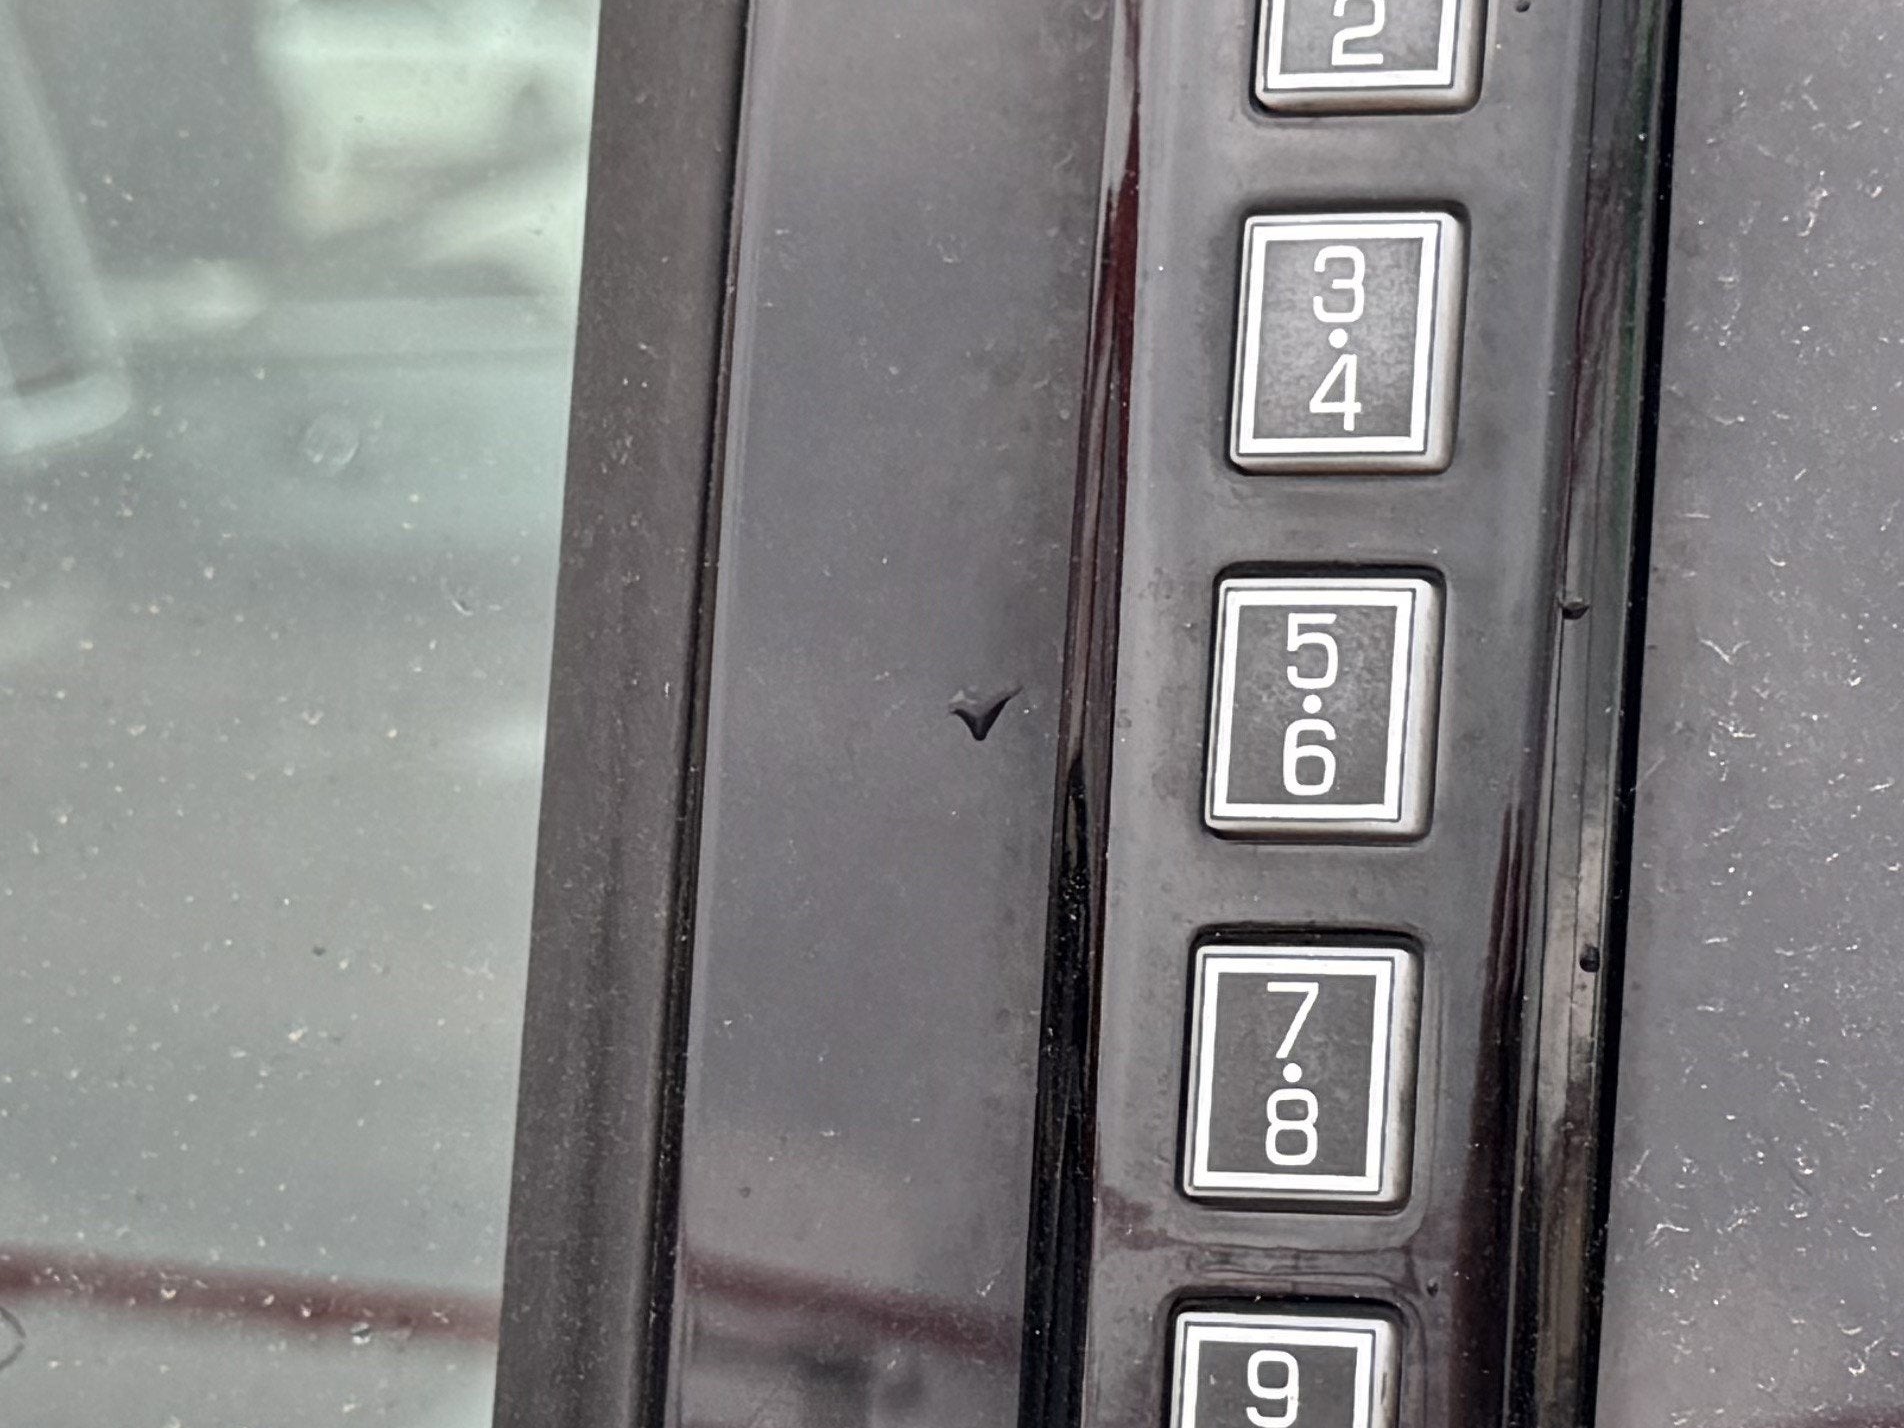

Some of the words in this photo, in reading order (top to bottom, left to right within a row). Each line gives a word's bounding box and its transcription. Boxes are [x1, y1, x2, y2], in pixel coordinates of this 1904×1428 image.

[1307, 243, 1367, 325] 3
[1308, 352, 1363, 433] 4
[1285, 611, 1340, 691] 5
[1281, 717, 1338, 797] 6
[1265, 980, 1320, 1060] 7
[1264, 1087, 1320, 1167] 8
